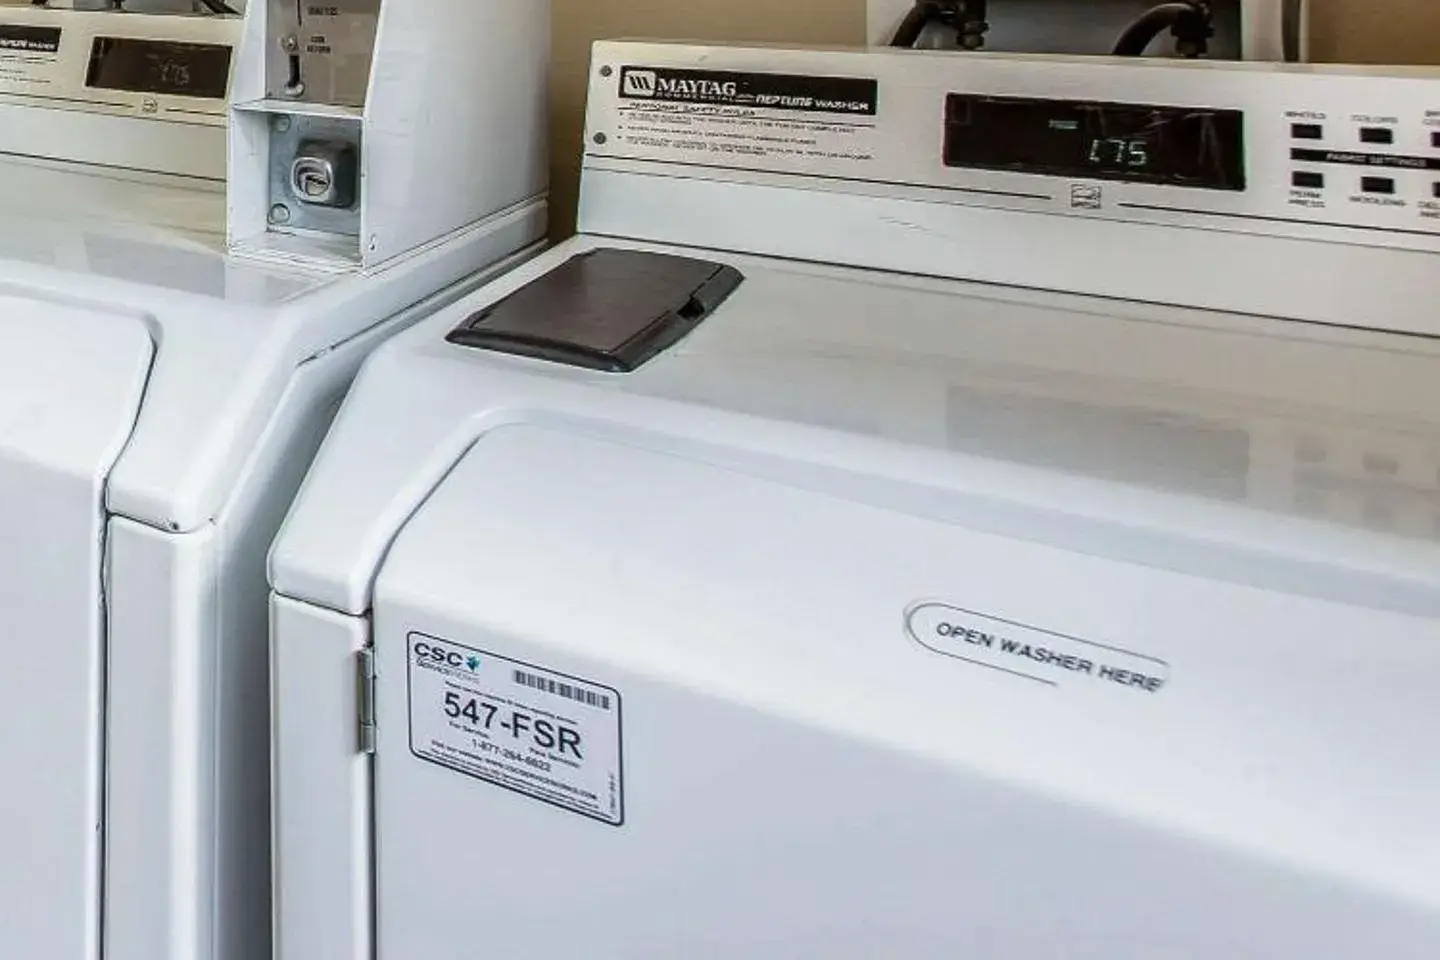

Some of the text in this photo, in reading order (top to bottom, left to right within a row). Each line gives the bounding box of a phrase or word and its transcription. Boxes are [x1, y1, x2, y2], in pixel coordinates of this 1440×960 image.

[658, 78, 737, 97] MAYTAG
[756, 94, 870, 111] NEPTUNE WASHER
[414, 642, 463, 667] CSC
[936, 621, 1164, 692] OPEN WASHER HERE
[444, 691, 584, 760] 547-FSR
